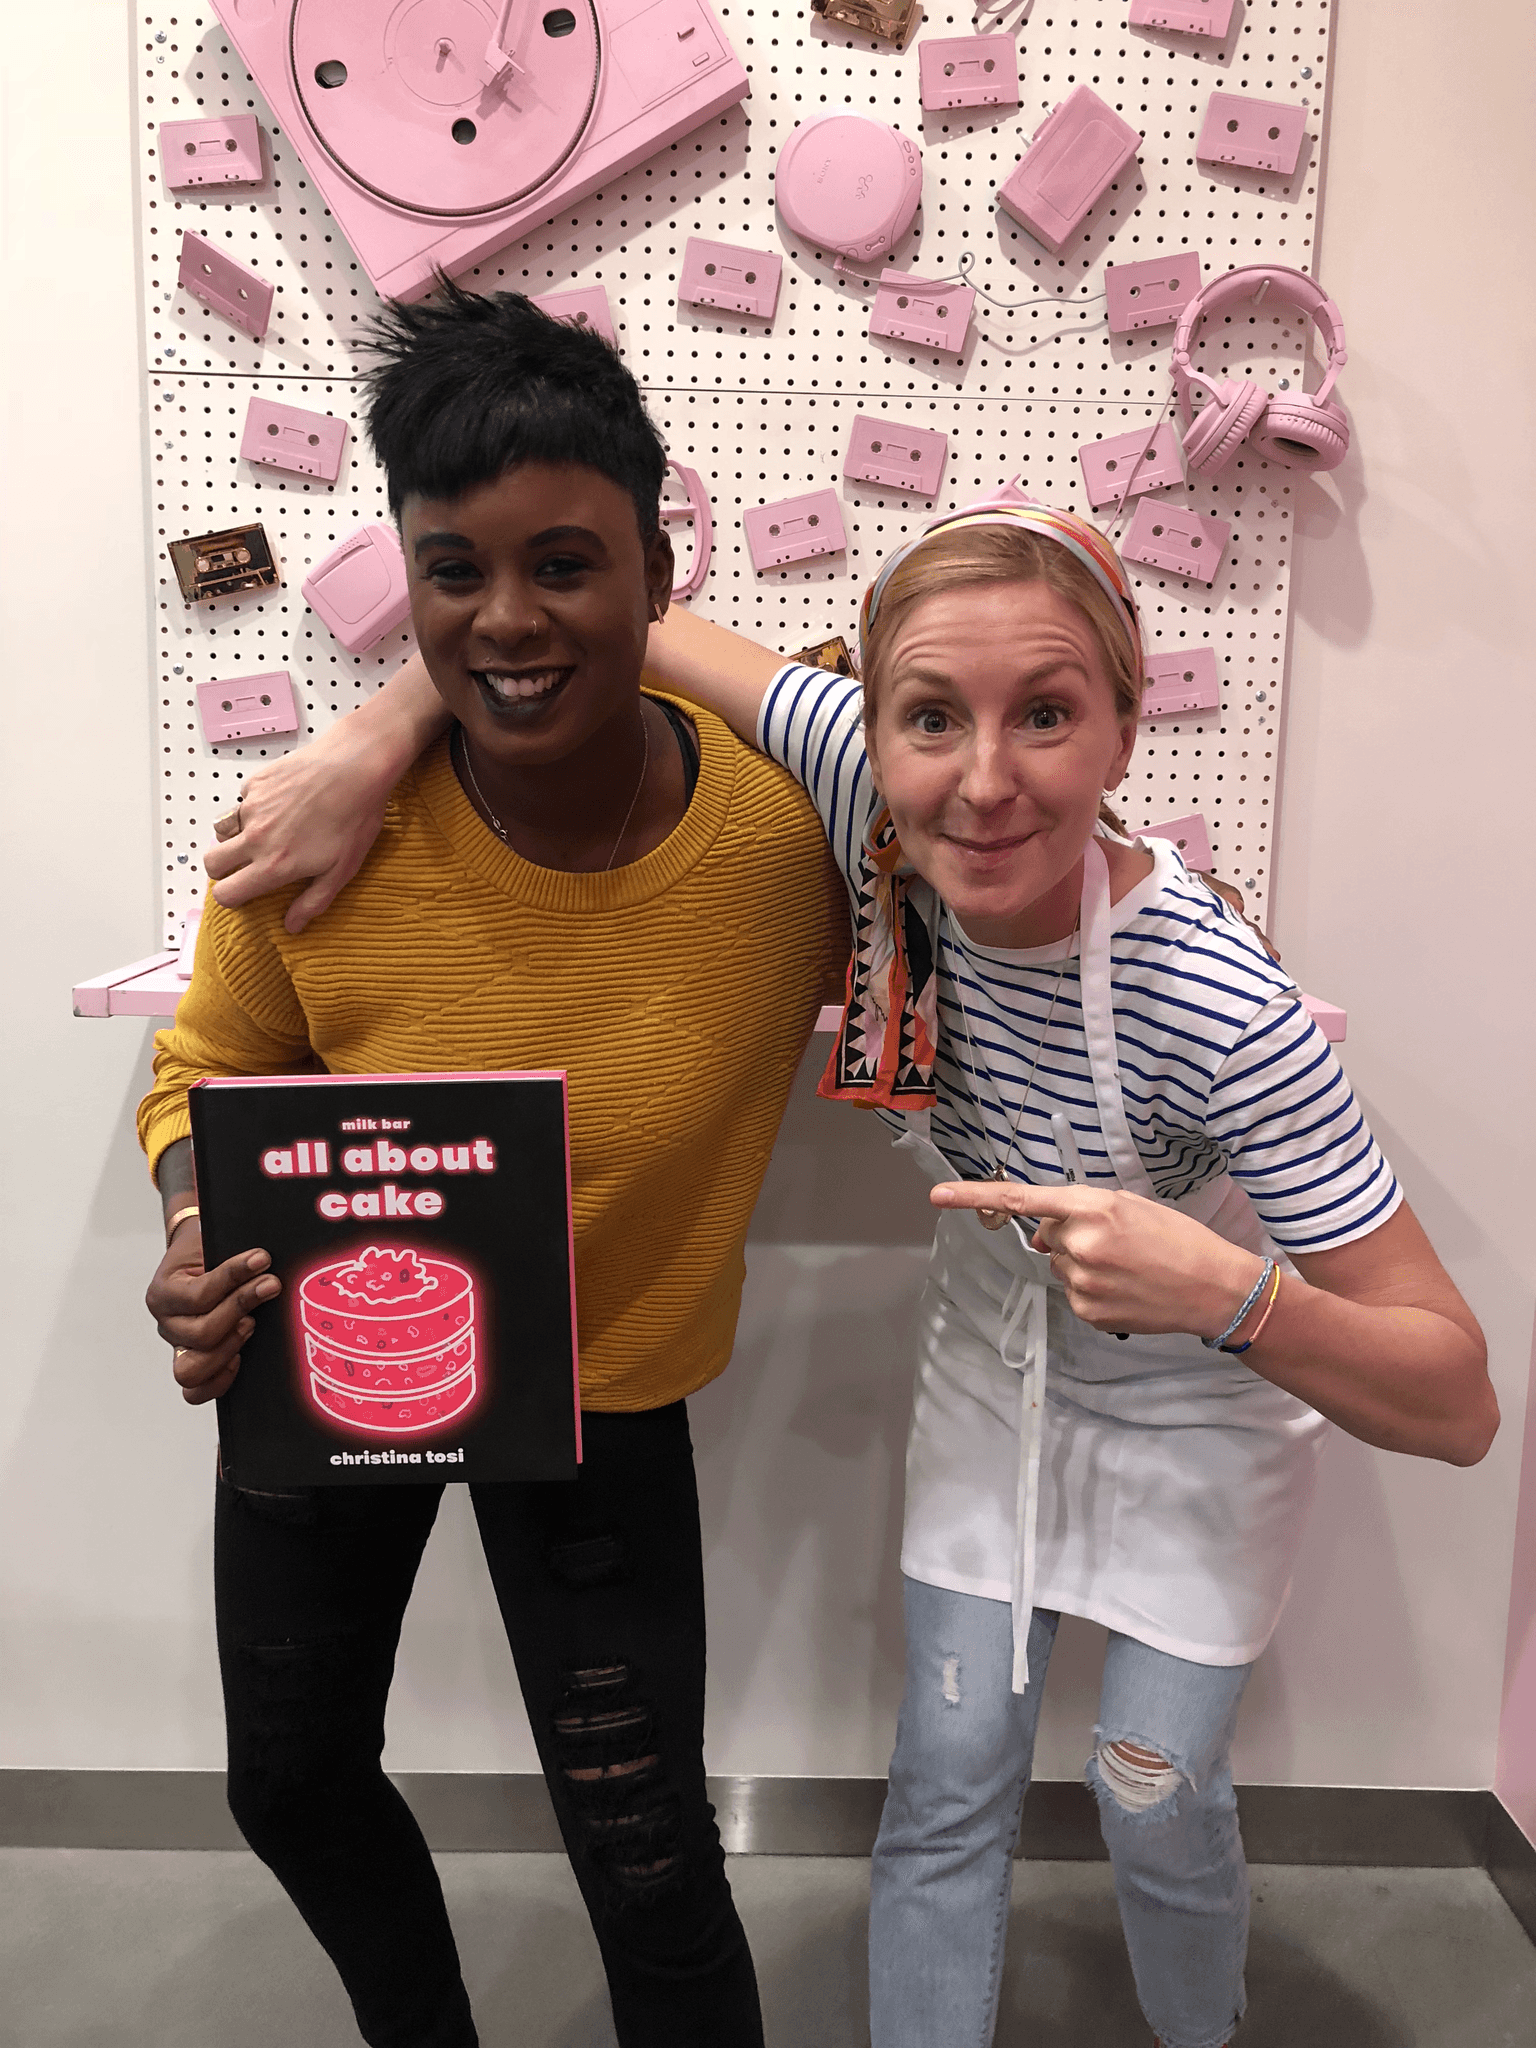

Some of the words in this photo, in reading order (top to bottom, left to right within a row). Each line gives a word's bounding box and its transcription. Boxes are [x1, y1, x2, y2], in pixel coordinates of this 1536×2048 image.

[341, 1118, 378, 1131] milk
[381, 1118, 411, 1130] bar
[263, 1142, 328, 1175] all
[343, 1140, 494, 1173] about
[319, 1185, 443, 1218] cake
[329, 1449, 422, 1466] christina
[425, 1447, 465, 1464] tosi
